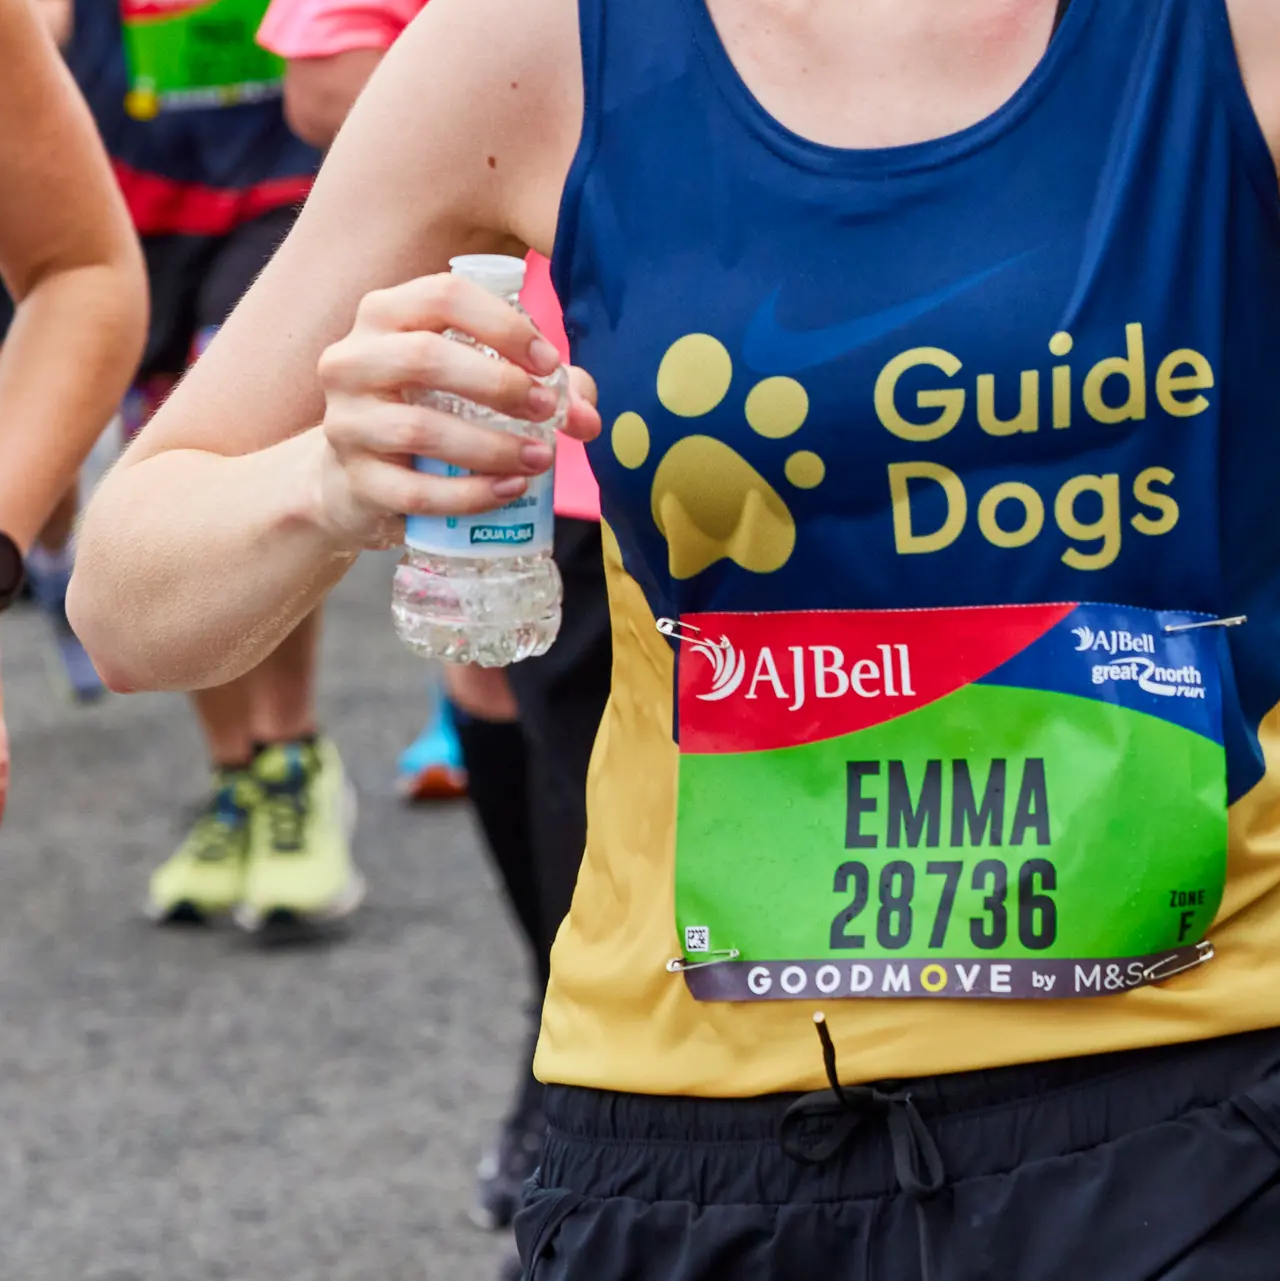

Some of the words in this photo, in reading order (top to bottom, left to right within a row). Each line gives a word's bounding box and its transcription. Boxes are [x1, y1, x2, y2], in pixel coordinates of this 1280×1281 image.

[873, 322, 1215, 442] Guide
[887, 460, 1180, 571] Dogs
[473, 528, 504, 541] AQUA
[506, 527, 532, 541] PURA
[1092, 630, 1155, 655] AJBell
[743, 643, 917, 712] AJBell
[1091, 662, 1139, 685] great
[1154, 665, 1202, 685] north
[1176, 686, 1205, 699] run
[844, 757, 1052, 850] EMMA
[828, 858, 1058, 951] 28736
[1168, 888, 1206, 909] ZONE
[1177, 910, 1196, 943] F
[746, 962, 1013, 996] GOODMOVE
[1031, 970, 1057, 993] by
[1073, 961, 1145, 993] M&S
